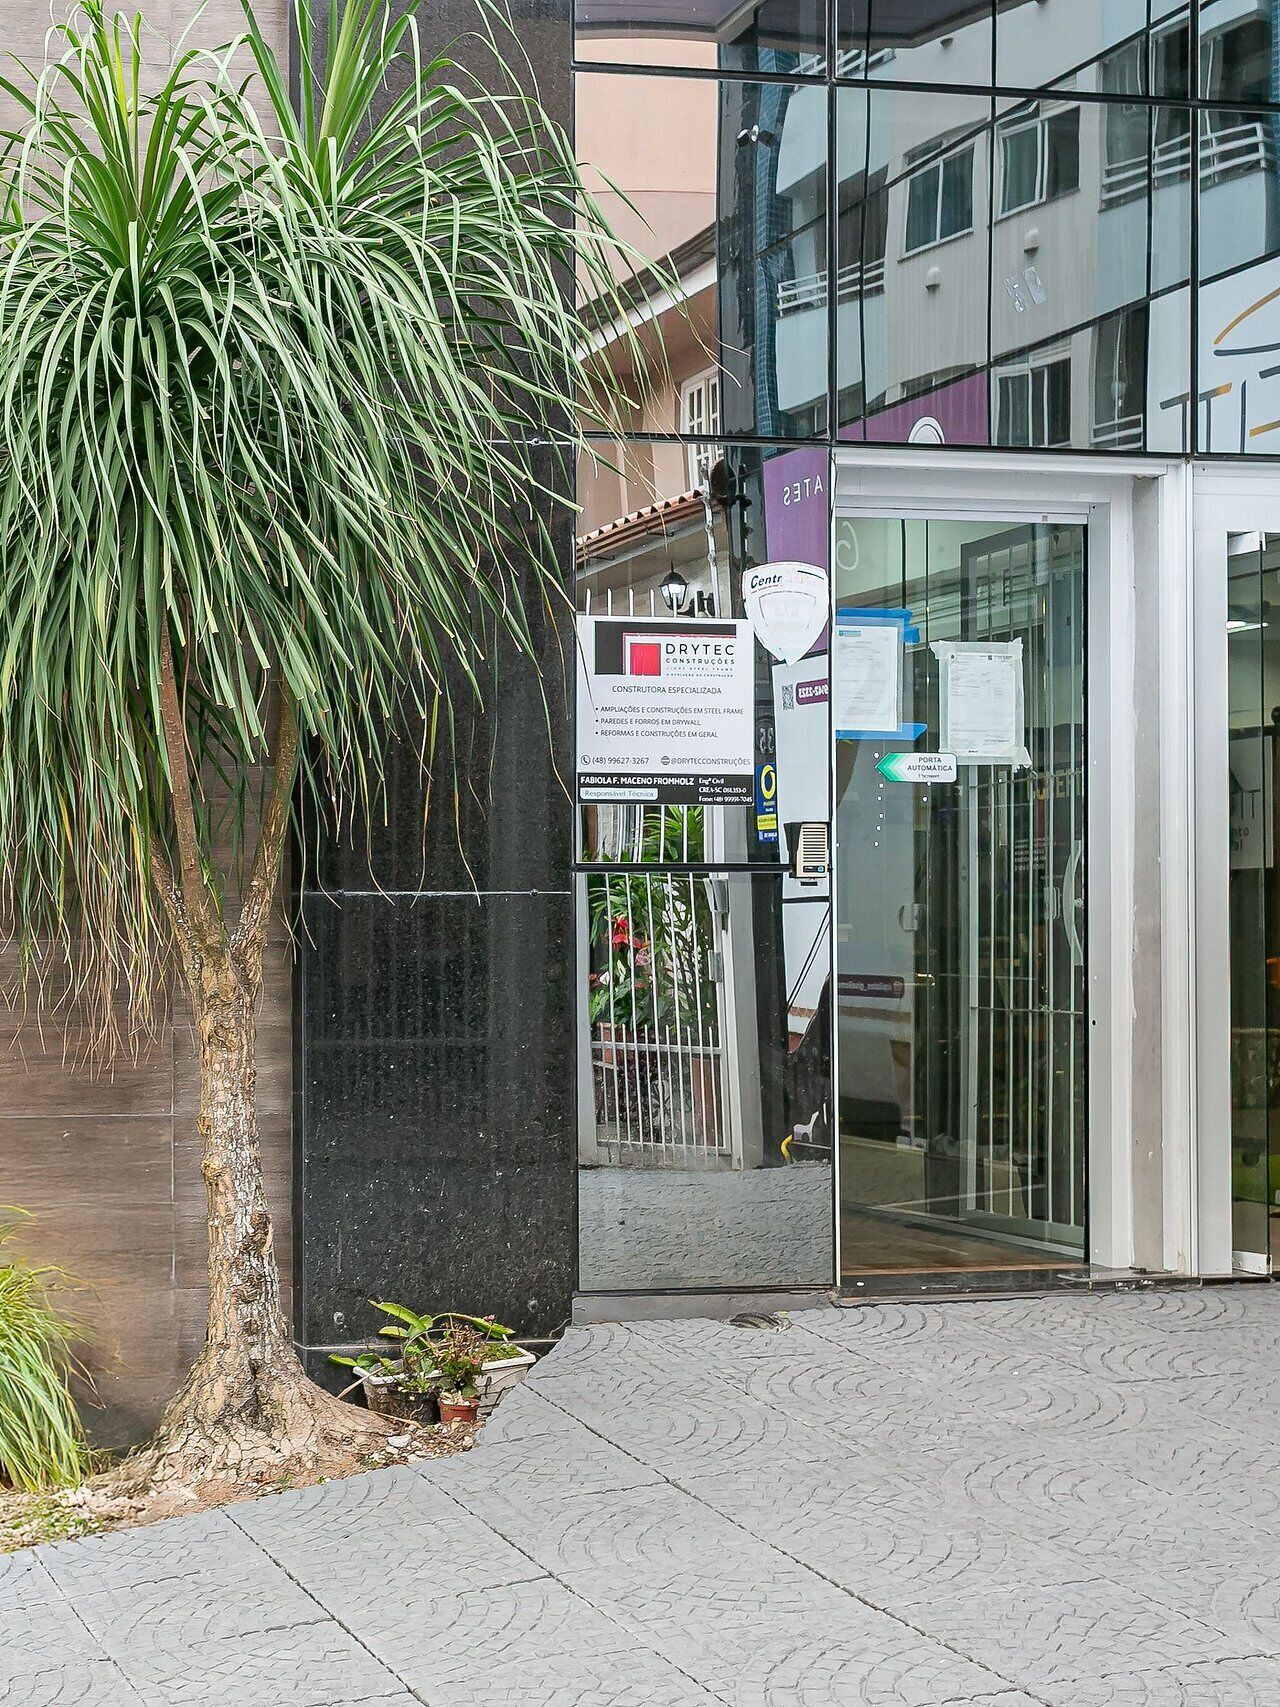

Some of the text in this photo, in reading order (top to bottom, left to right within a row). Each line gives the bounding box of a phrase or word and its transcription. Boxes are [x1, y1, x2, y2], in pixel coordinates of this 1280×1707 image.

[665, 643, 734, 656] DRYTEC
[665, 657, 735, 666] CONSTRUÇÕES
[612, 685, 722, 695] CONSTRUTORA ESPECIALIZADA
[600, 705, 640, 714] AMPLIAÇÕES
[646, 706, 692, 715] CONSTRUÇÕES
[723, 707, 744, 715] FRAME
[600, 729, 634, 737] REFORMAS
[640, 730, 686, 738] CONSTRUÇÕES
[592, 757, 649, 765] (48) 99627-3267
[671, 757, 751, 766] @DRYTECCONSTRUÇÕES
[907, 764, 953, 772] AUTOMÁTICA
[580, 776, 612, 784] FABIOLA
[620, 777, 653, 785] MACENO
[653, 777, 694, 786] FROMHOLZ
[584, 789, 654, 798] Responsável Técnica
